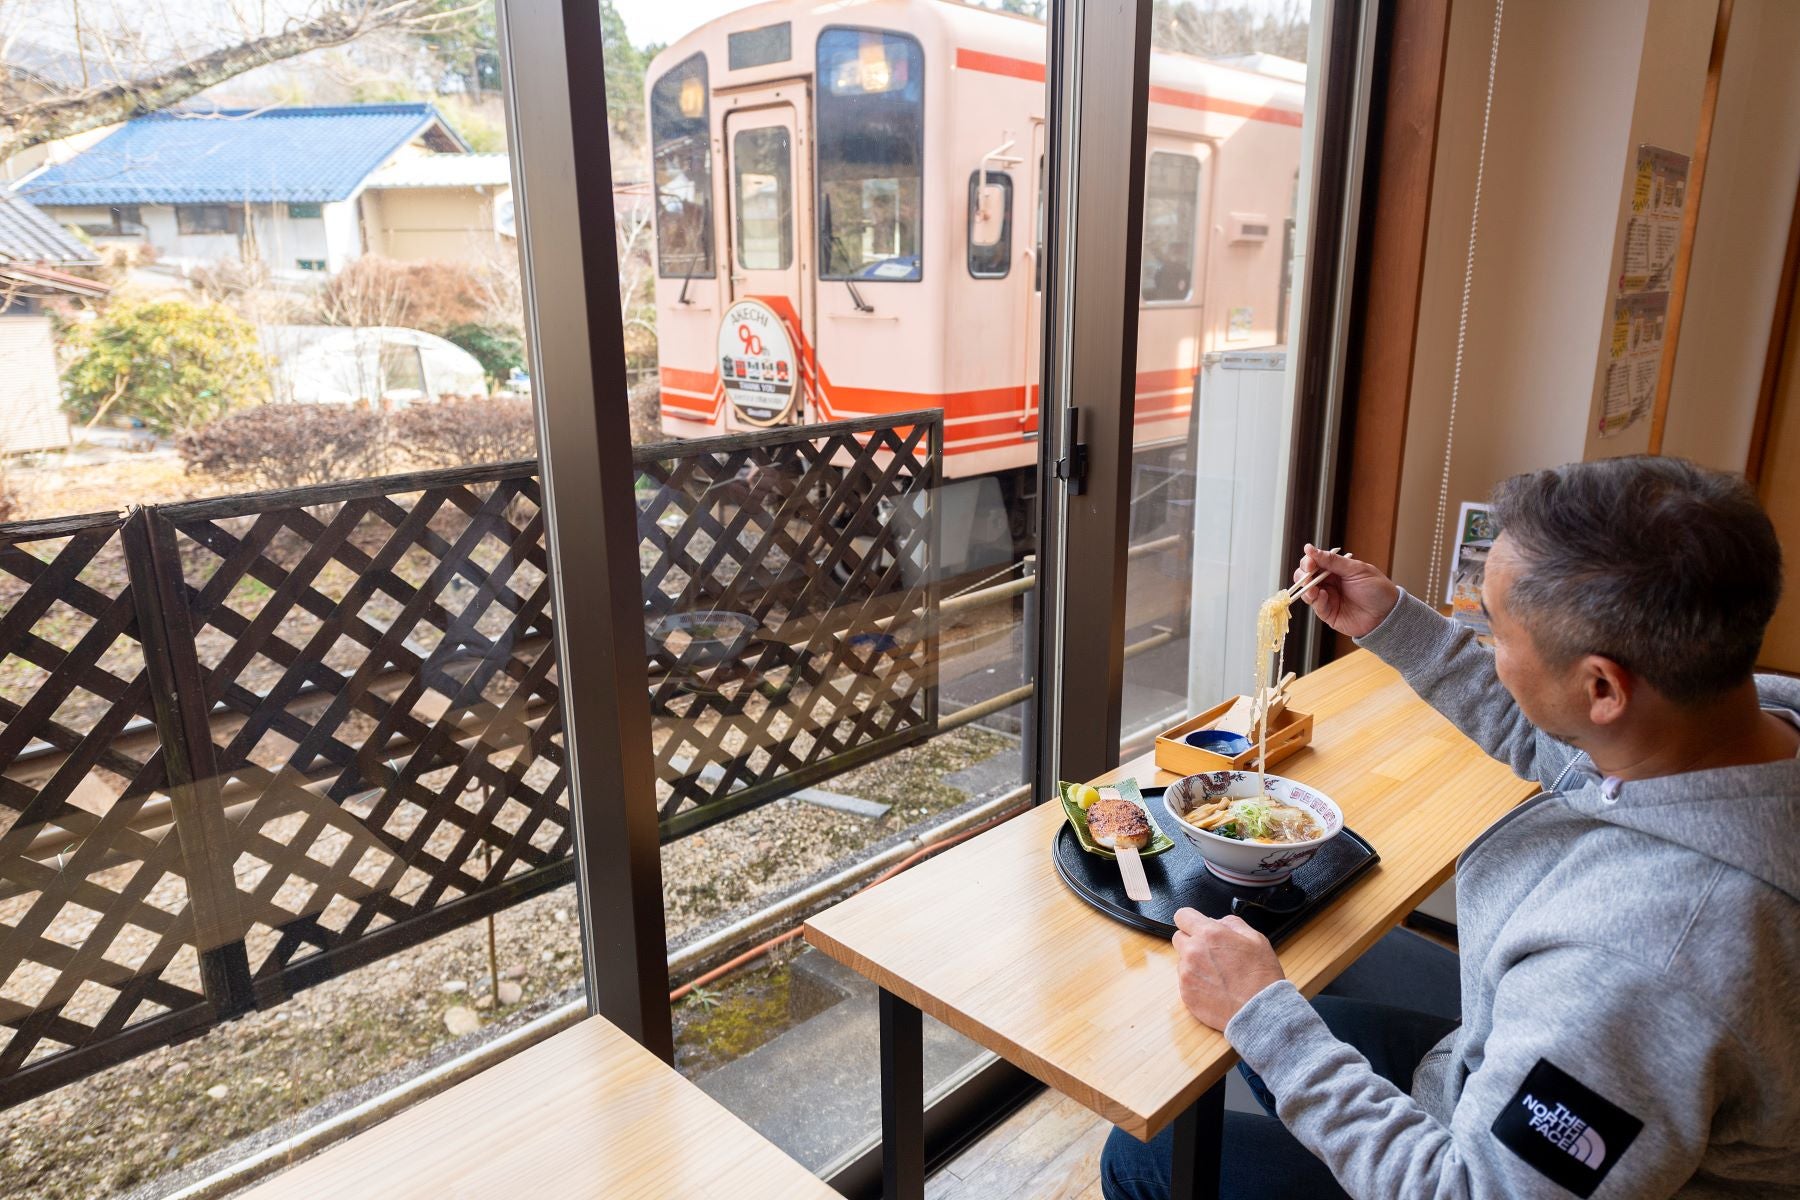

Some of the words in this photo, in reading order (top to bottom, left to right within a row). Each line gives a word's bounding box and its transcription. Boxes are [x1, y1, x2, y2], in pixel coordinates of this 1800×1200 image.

[731, 308, 768, 326] AKECHI
[761, 384, 775, 393] YOU
[1522, 1094, 1580, 1144] NORTH
[1554, 1102, 1586, 1132] THE
[1529, 1116, 1570, 1151] FACE
